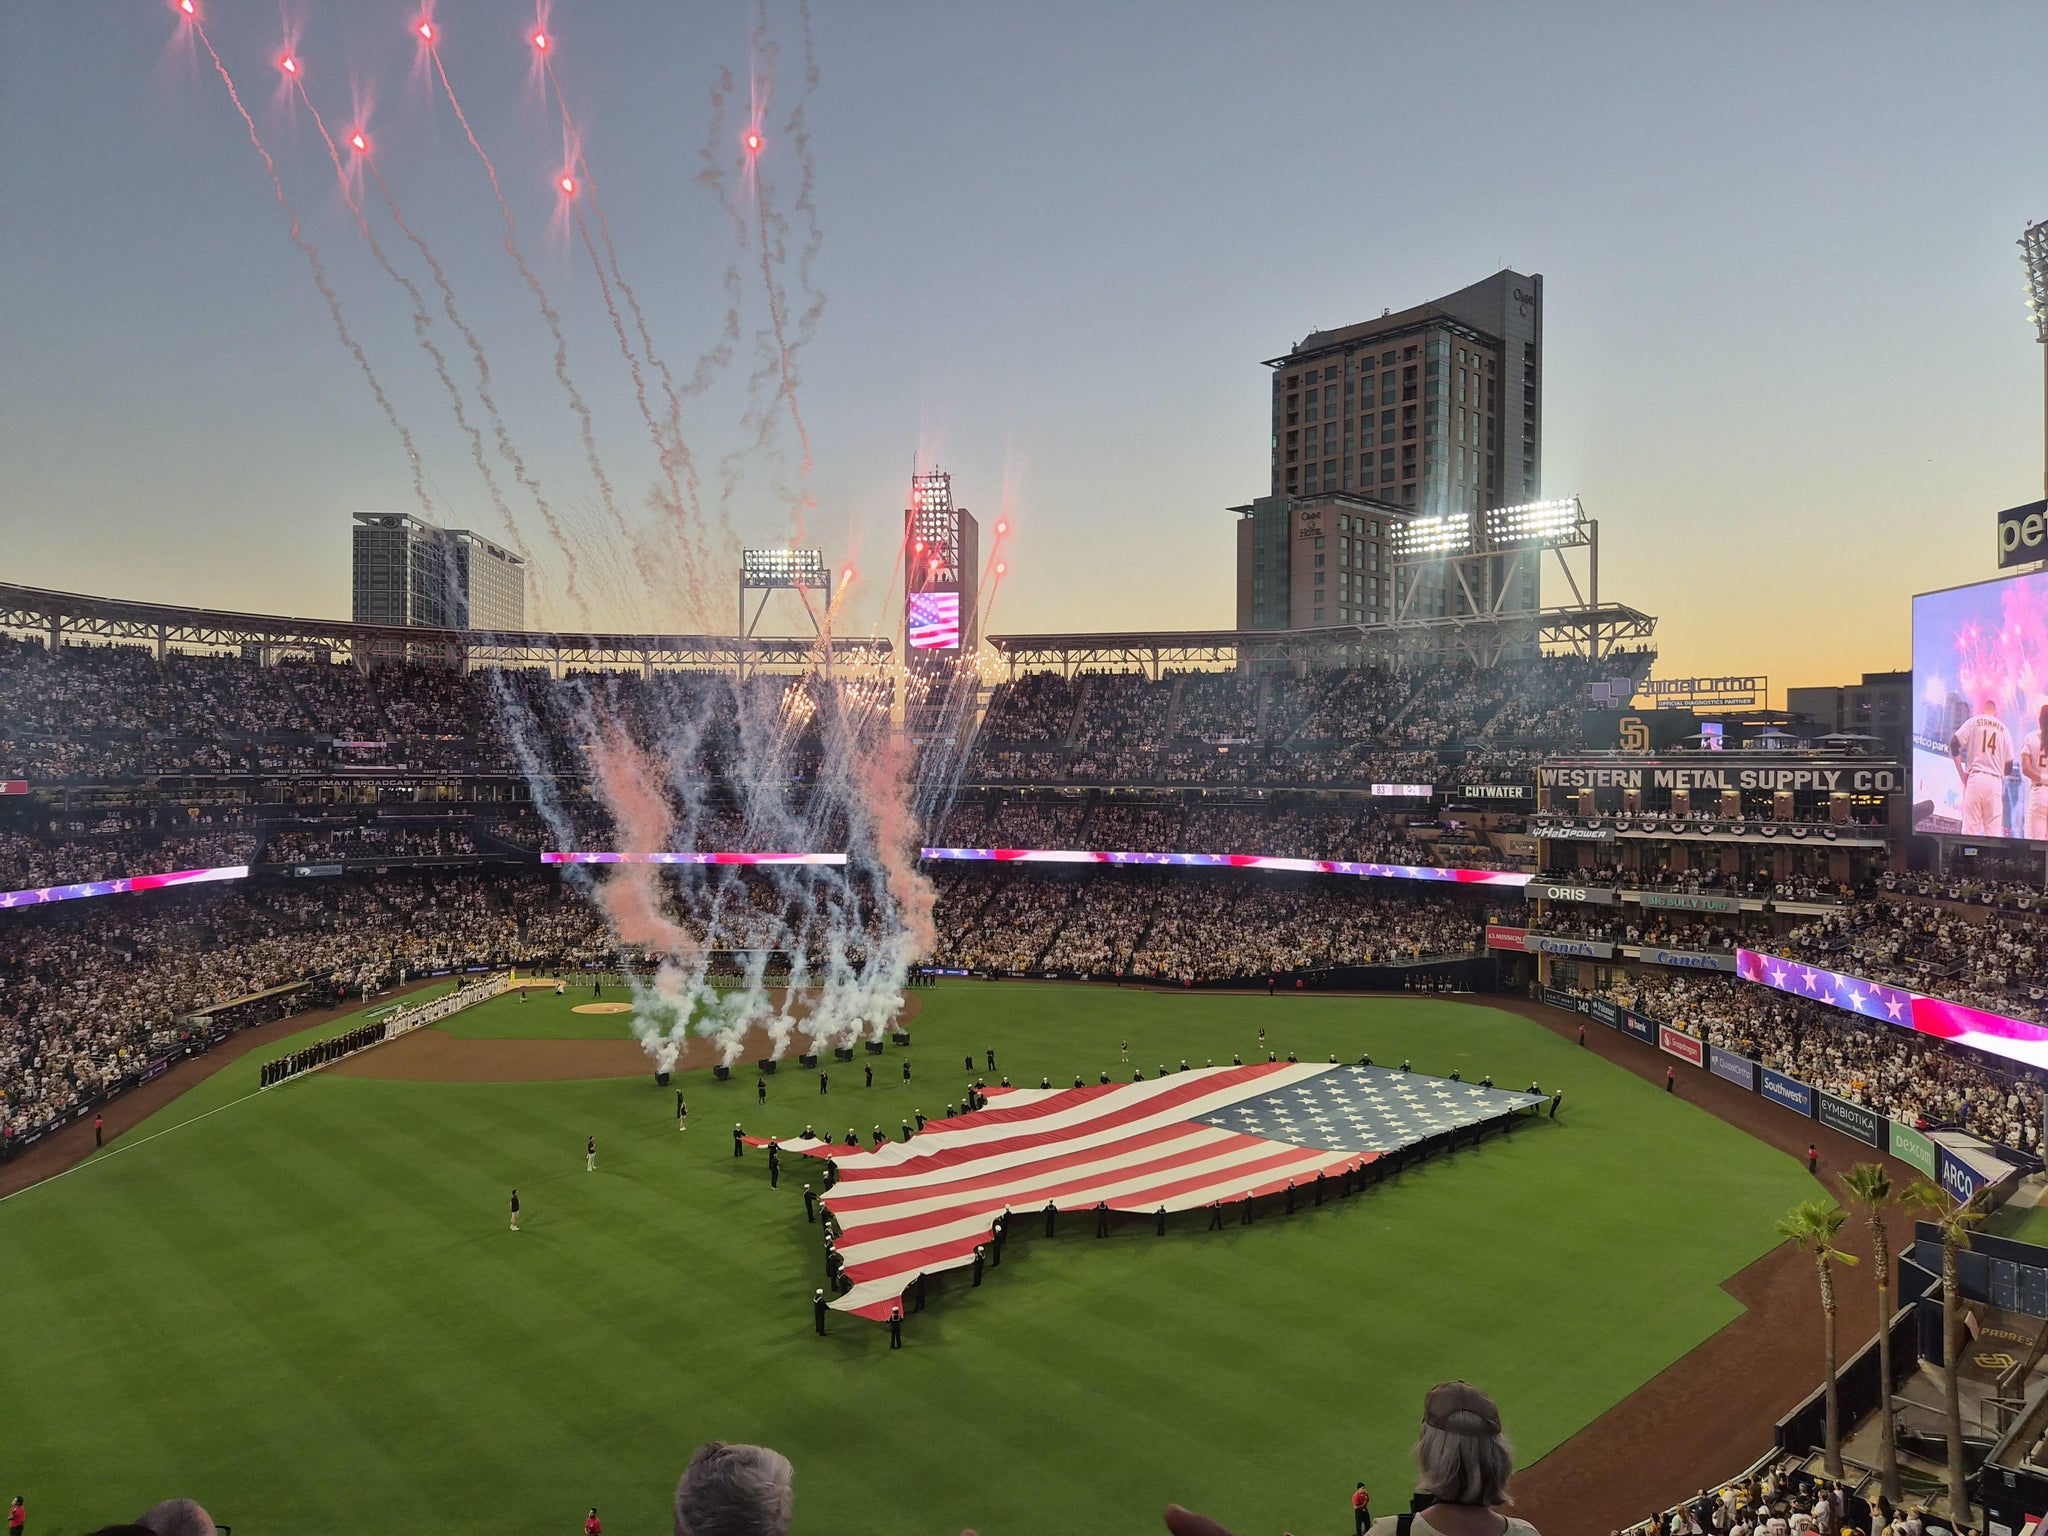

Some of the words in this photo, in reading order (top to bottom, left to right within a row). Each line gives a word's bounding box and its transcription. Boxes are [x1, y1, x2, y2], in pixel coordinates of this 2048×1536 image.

[1931, 740, 1950, 754] park
[1981, 730, 1997, 755] 14
[260, 779, 293, 787] JERRY
[299, 779, 349, 787] COLEMAN
[353, 779, 417, 787] BROADCAST
[421, 779, 463, 787] CENTER
[1540, 769, 1642, 788] WESTERN
[1654, 769, 1732, 789] METAL
[1740, 770, 1841, 791] SUPPLY
[1853, 770, 1902, 791] CO.
[1465, 786, 1523, 798] CUTWATER
[1547, 887, 1586, 901] ORIS
[1667, 898, 1698, 908] BULLY
[1701, 900, 1729, 911] TURF
[1496, 934, 1522, 942] MISSION
[1577, 1001, 1590, 1013] 342
[1671, 1037, 1698, 1057] Snapdragon
[1764, 1077, 1802, 1104] Southwest
[1821, 1100, 1875, 1131] CYMBIOTIKA
[1943, 1159, 1974, 1199] ARCO
[1980, 1327, 2034, 1346] PADRES
